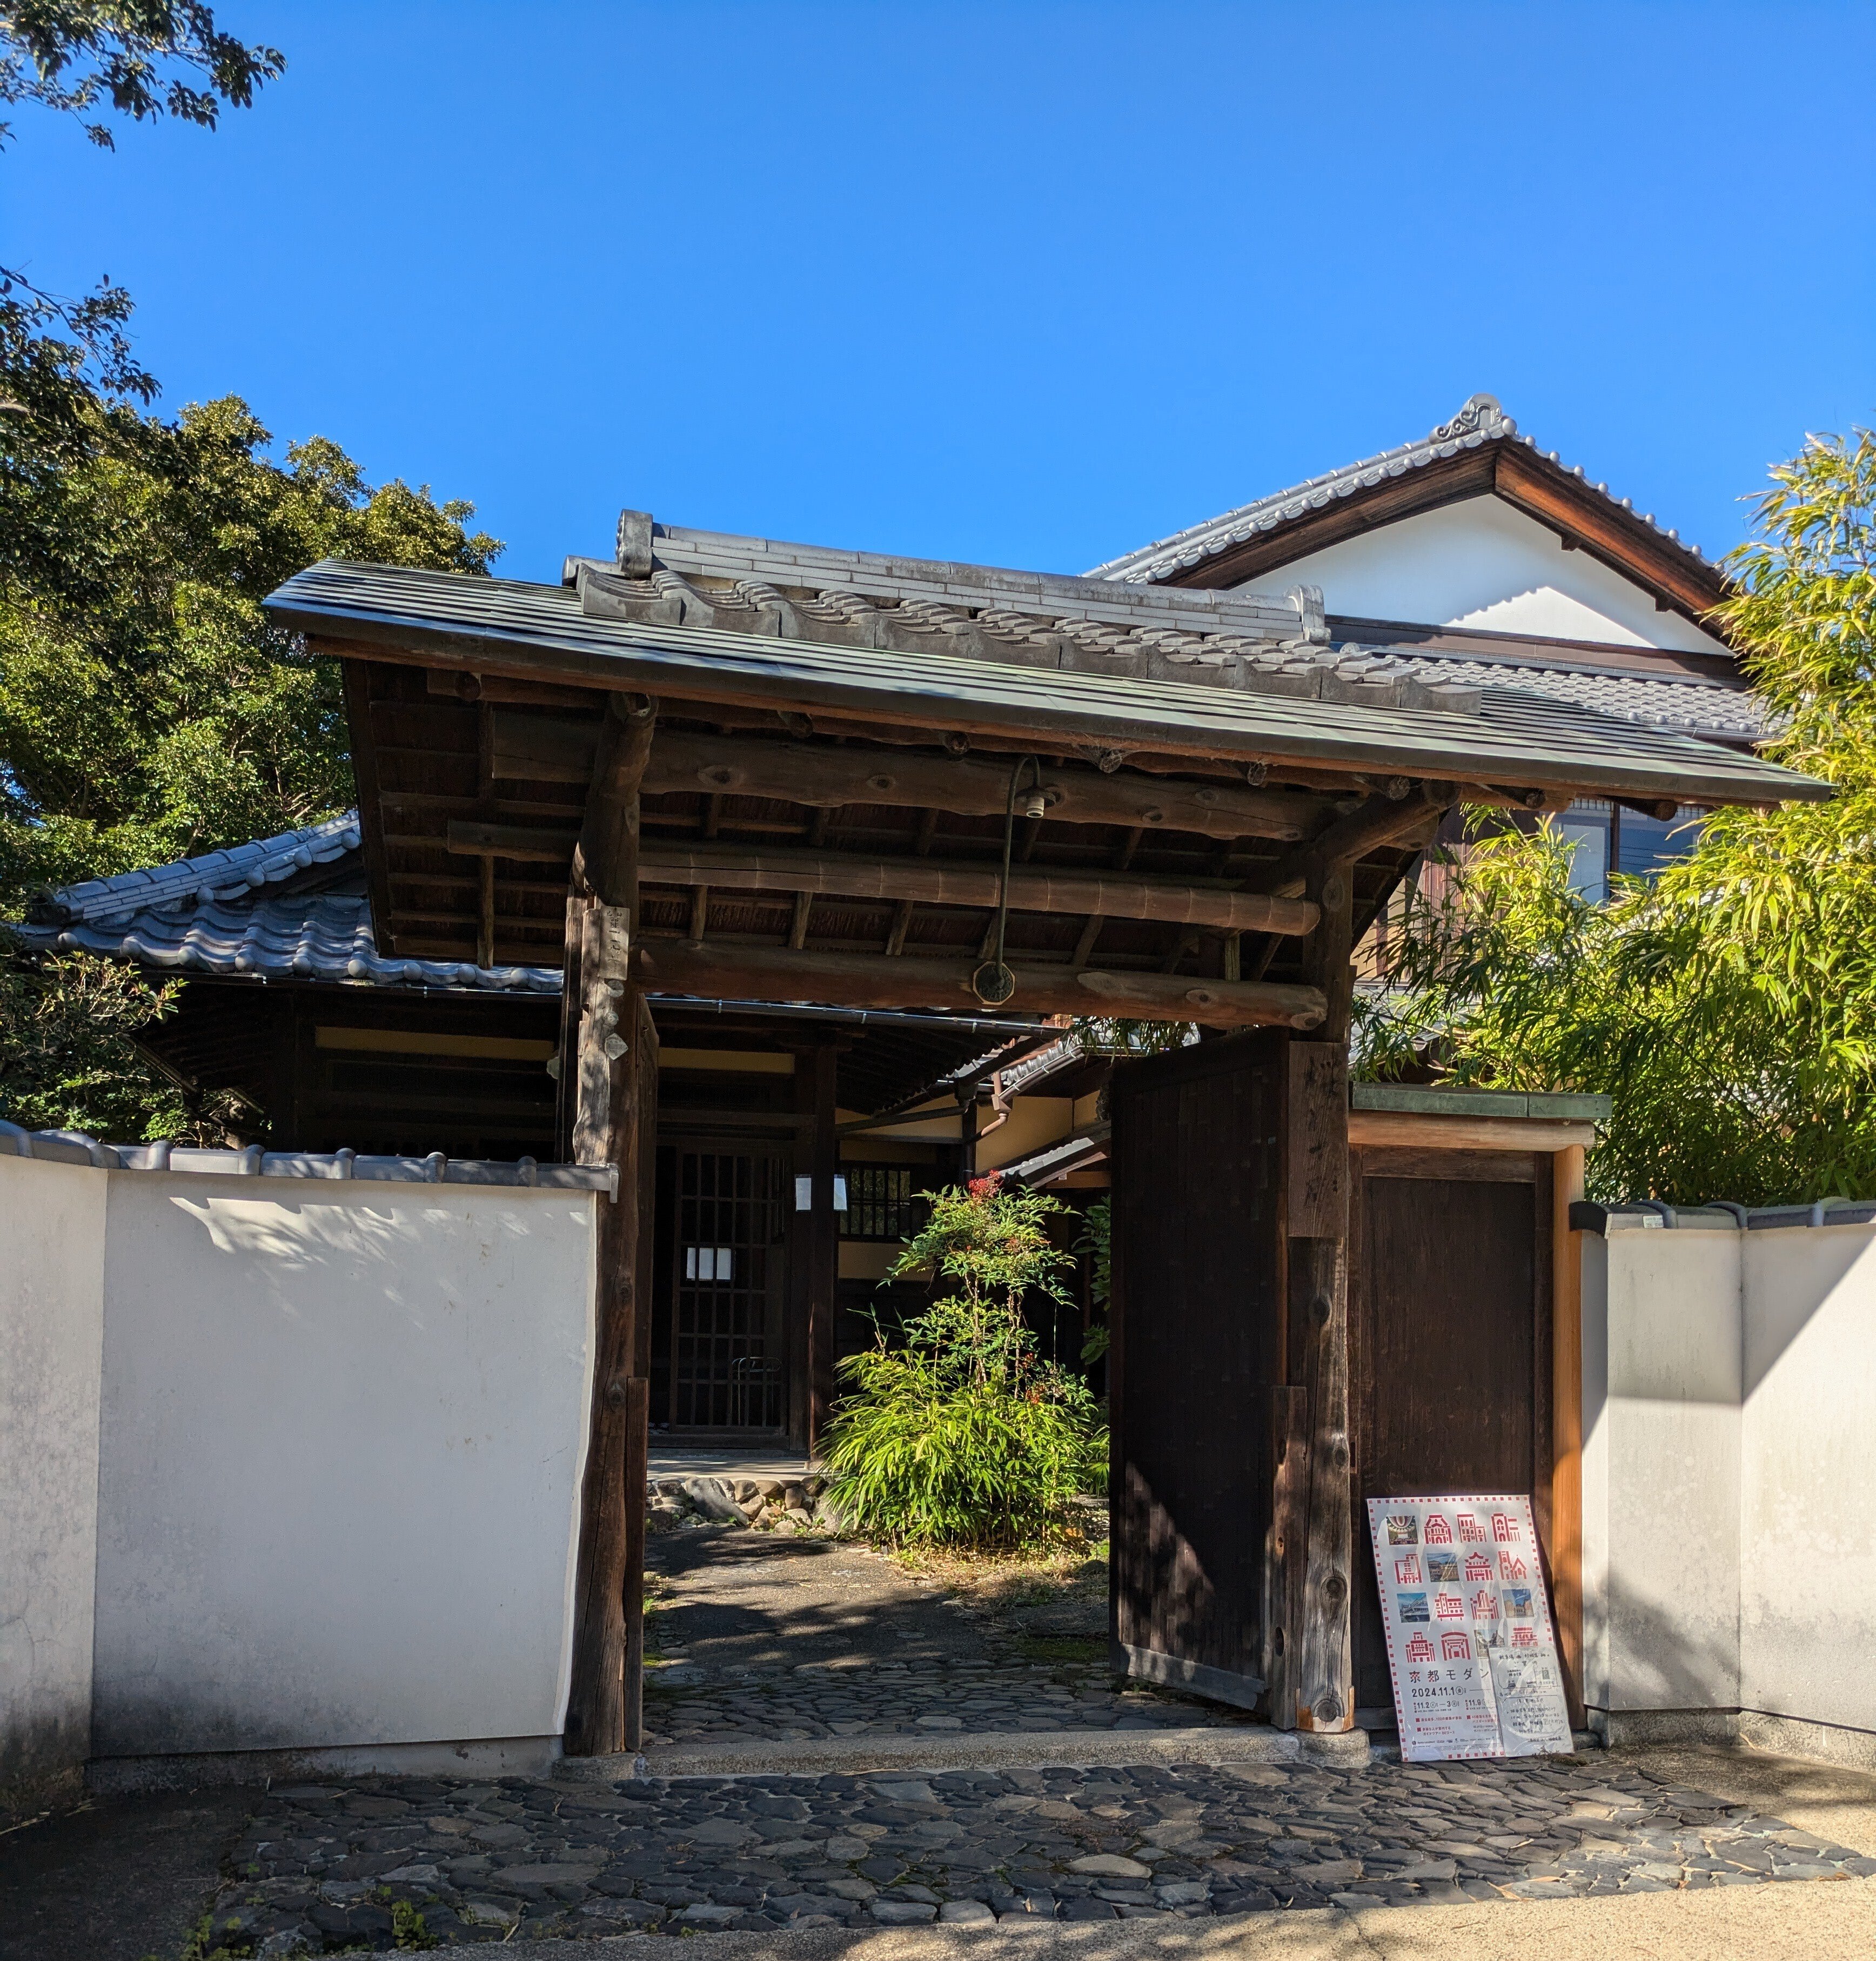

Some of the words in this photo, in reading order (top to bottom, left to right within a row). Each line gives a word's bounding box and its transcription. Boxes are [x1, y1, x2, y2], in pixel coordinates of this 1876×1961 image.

[1409, 1668, 1489, 1683] 京都モダン
[1411, 1686, 1455, 1697] 2024.11.1
